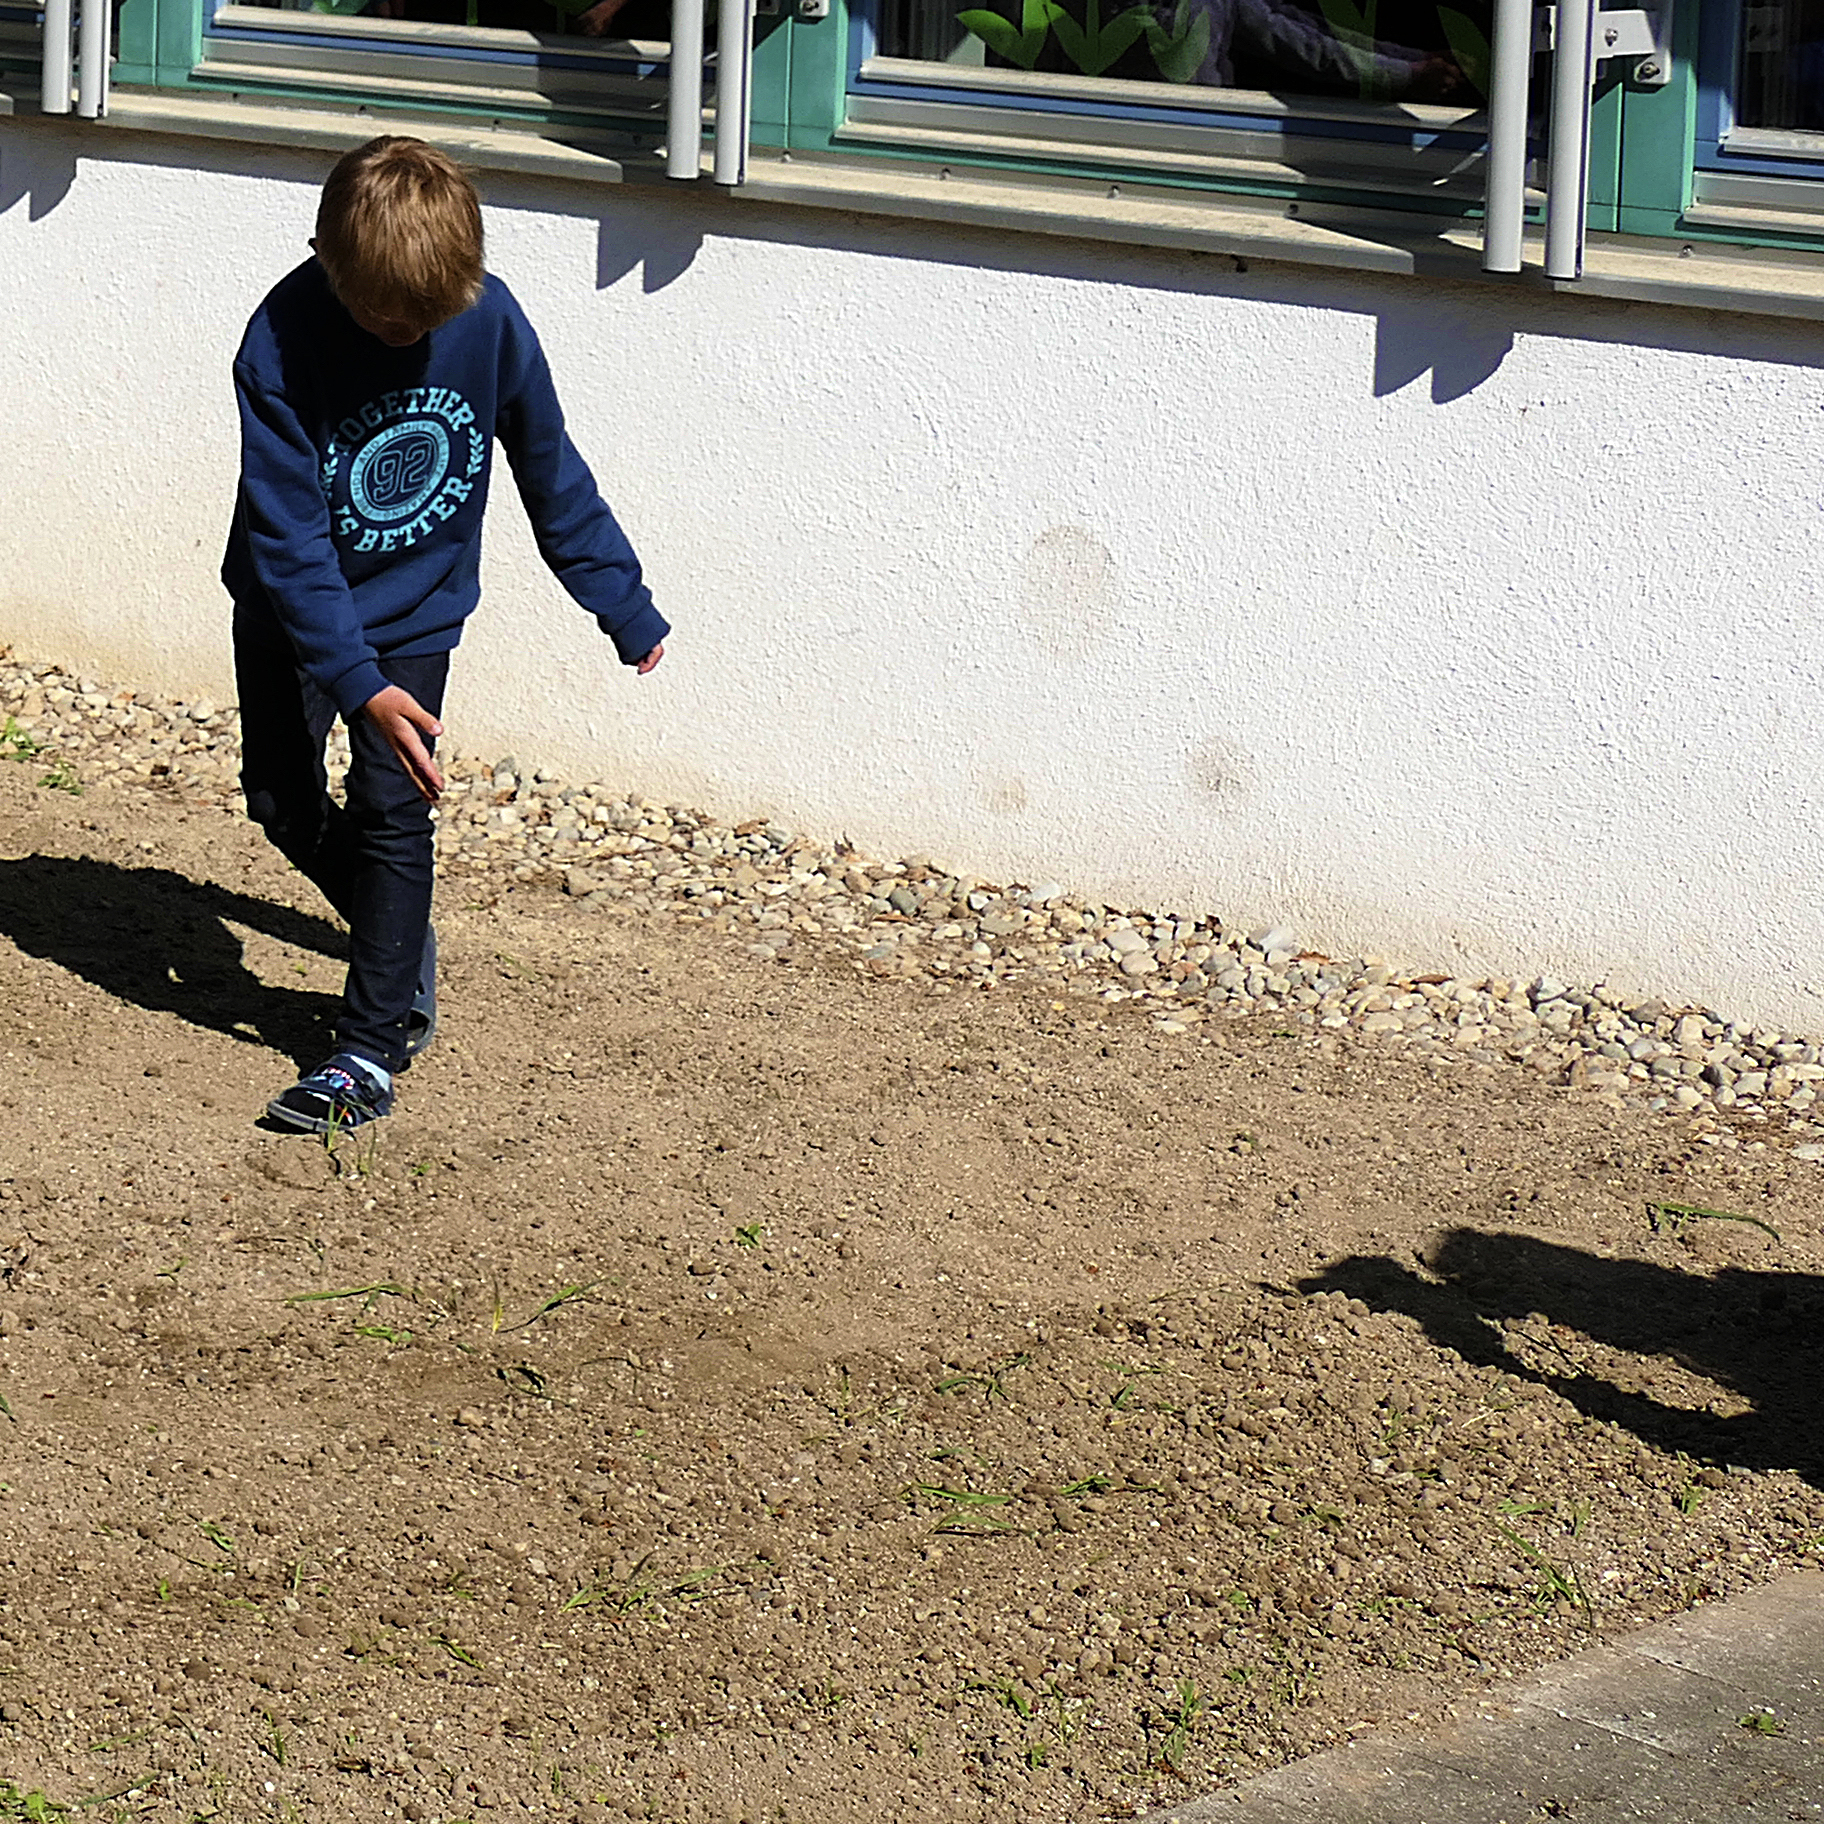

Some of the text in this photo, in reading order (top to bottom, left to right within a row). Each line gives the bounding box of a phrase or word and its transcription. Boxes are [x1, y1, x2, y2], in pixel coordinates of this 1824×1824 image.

[331, 386, 475, 456] TOGETHER
[373, 439, 433, 503] 92
[333, 504, 359, 536] IS
[353, 476, 474, 552] BETTER
